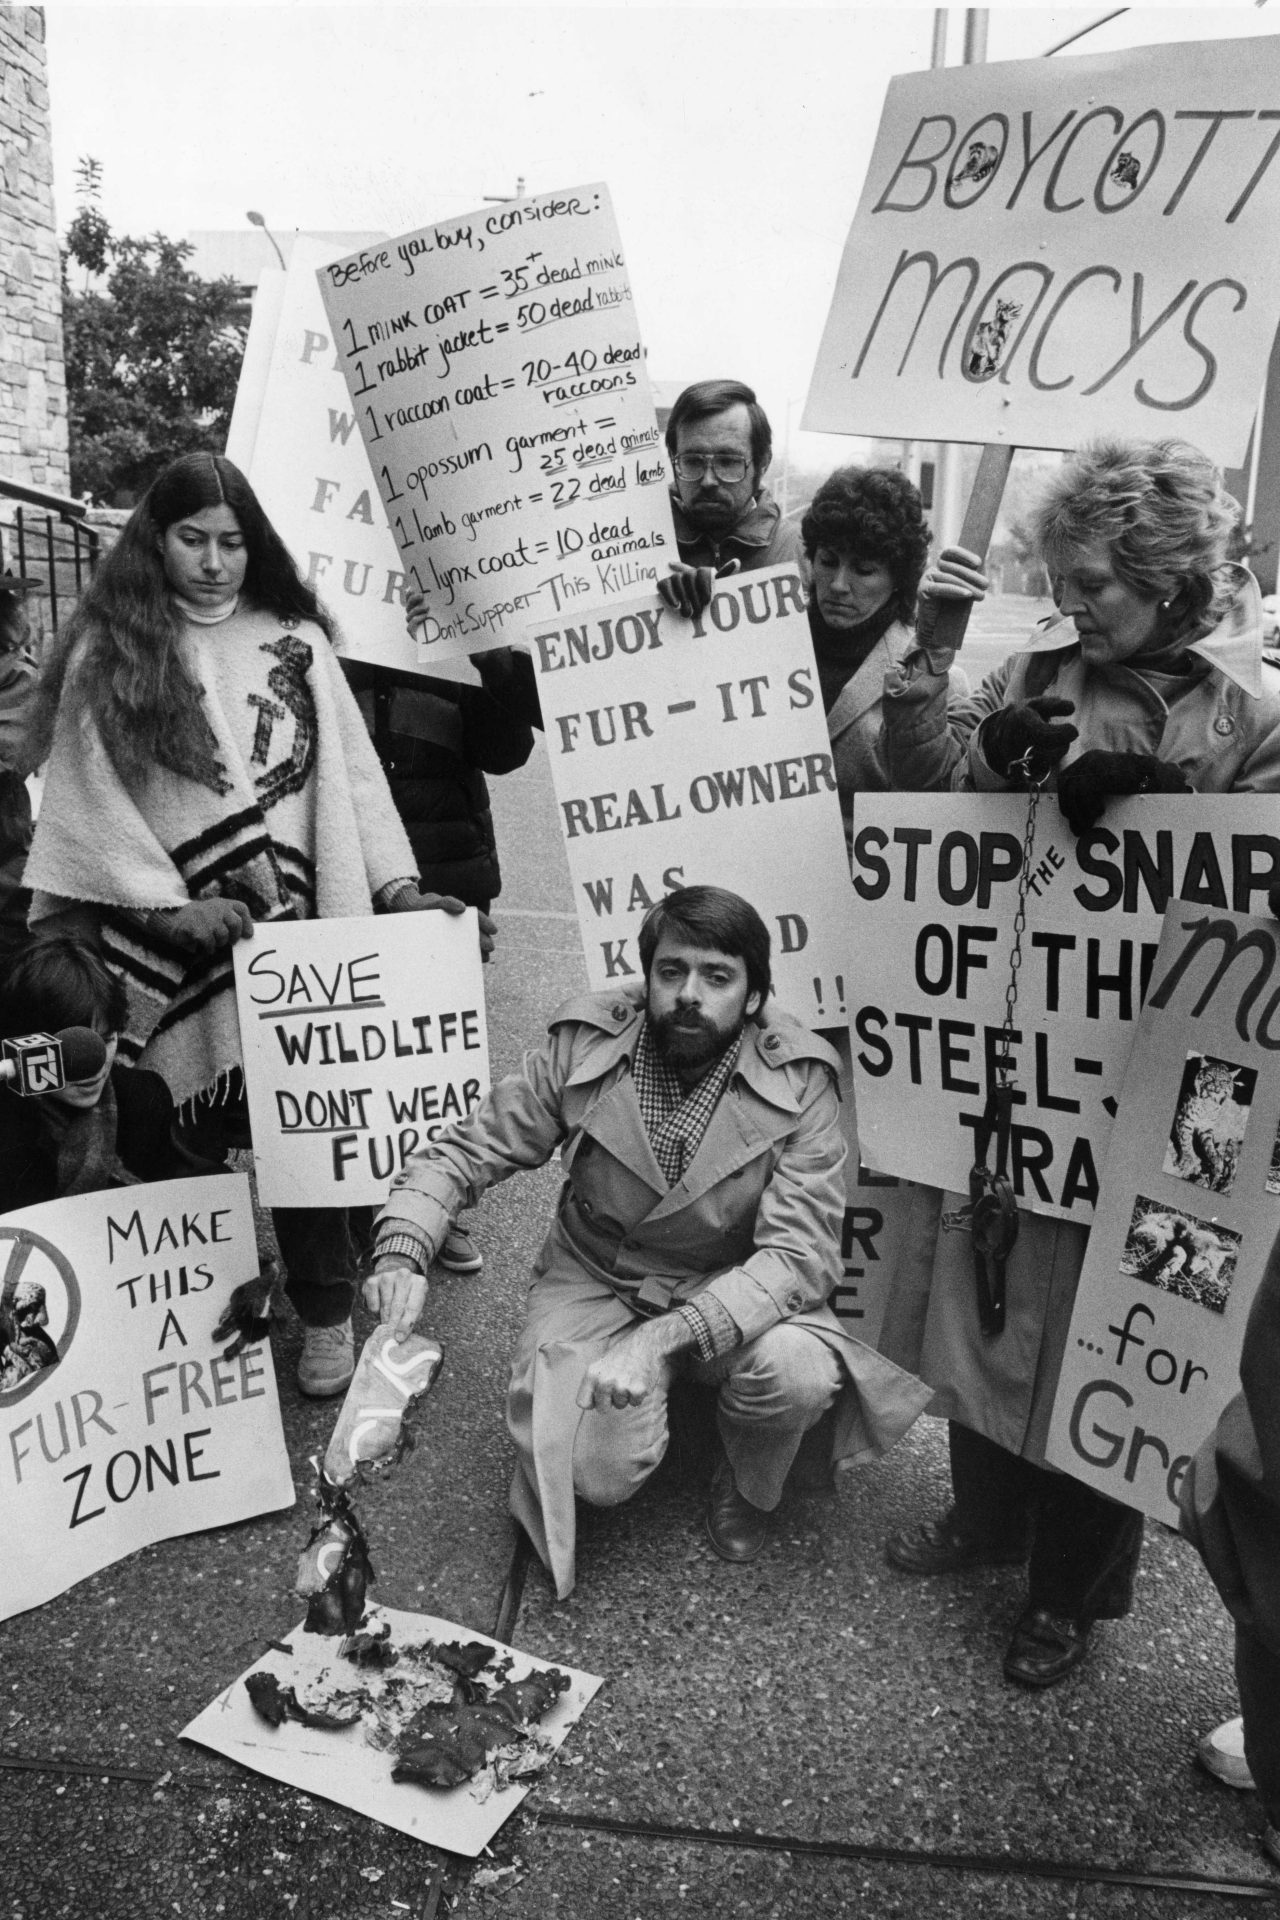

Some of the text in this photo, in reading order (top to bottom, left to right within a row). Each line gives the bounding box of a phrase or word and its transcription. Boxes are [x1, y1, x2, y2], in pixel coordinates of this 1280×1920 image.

[870, 105, 1280, 224] BOYCOTT
[327, 251, 391, 287] Before
[397, 238, 434, 276] you
[435, 226, 485, 252] buy,
[343, 318, 369, 357] 1
[536, 257, 582, 285] dead
[354, 361, 377, 396] 1
[378, 344, 429, 381] rabbit
[437, 319, 494, 379] jacket
[517, 302, 546, 327] 50
[549, 286, 594, 319] dead
[365, 405, 384, 442] 1
[385, 396, 450, 431] raccoon
[455, 374, 499, 405] coat
[603, 342, 641, 365] dead
[542, 371, 636, 403] raccoons
[381, 465, 404, 503] 1
[406, 442, 492, 501] opossum
[506, 418, 588, 473] garment
[540, 447, 566, 469] 25
[572, 437, 617, 462] dead
[396, 515, 414, 549] 1
[412, 508, 456, 543] lamb
[461, 494, 523, 541] garment
[550, 478, 581, 503] 22
[589, 465, 627, 493] dead
[410, 565, 431, 594] 1
[428, 557, 478, 605] lynx
[478, 537, 539, 575] coat
[556, 528, 584, 555] 10
[588, 516, 634, 544] dead
[591, 531, 666, 561] animals
[534, 607, 664, 673] ENJOY
[555, 700, 655, 754] FUR
[561, 753, 838, 838] REAL OWNER
[852, 826, 1280, 914] STOP THE SNAP
[248, 949, 381, 1005] SAVE
[915, 923, 998, 999] OF
[275, 1010, 481, 1066] WILDLIFE
[387, 1078, 481, 1124] WEAR
[107, 1209, 233, 1265] MAKE
[116, 1263, 214, 1309] THIS
[158, 1308, 188, 1351] A
[62, 1427, 221, 1529] ZONE
